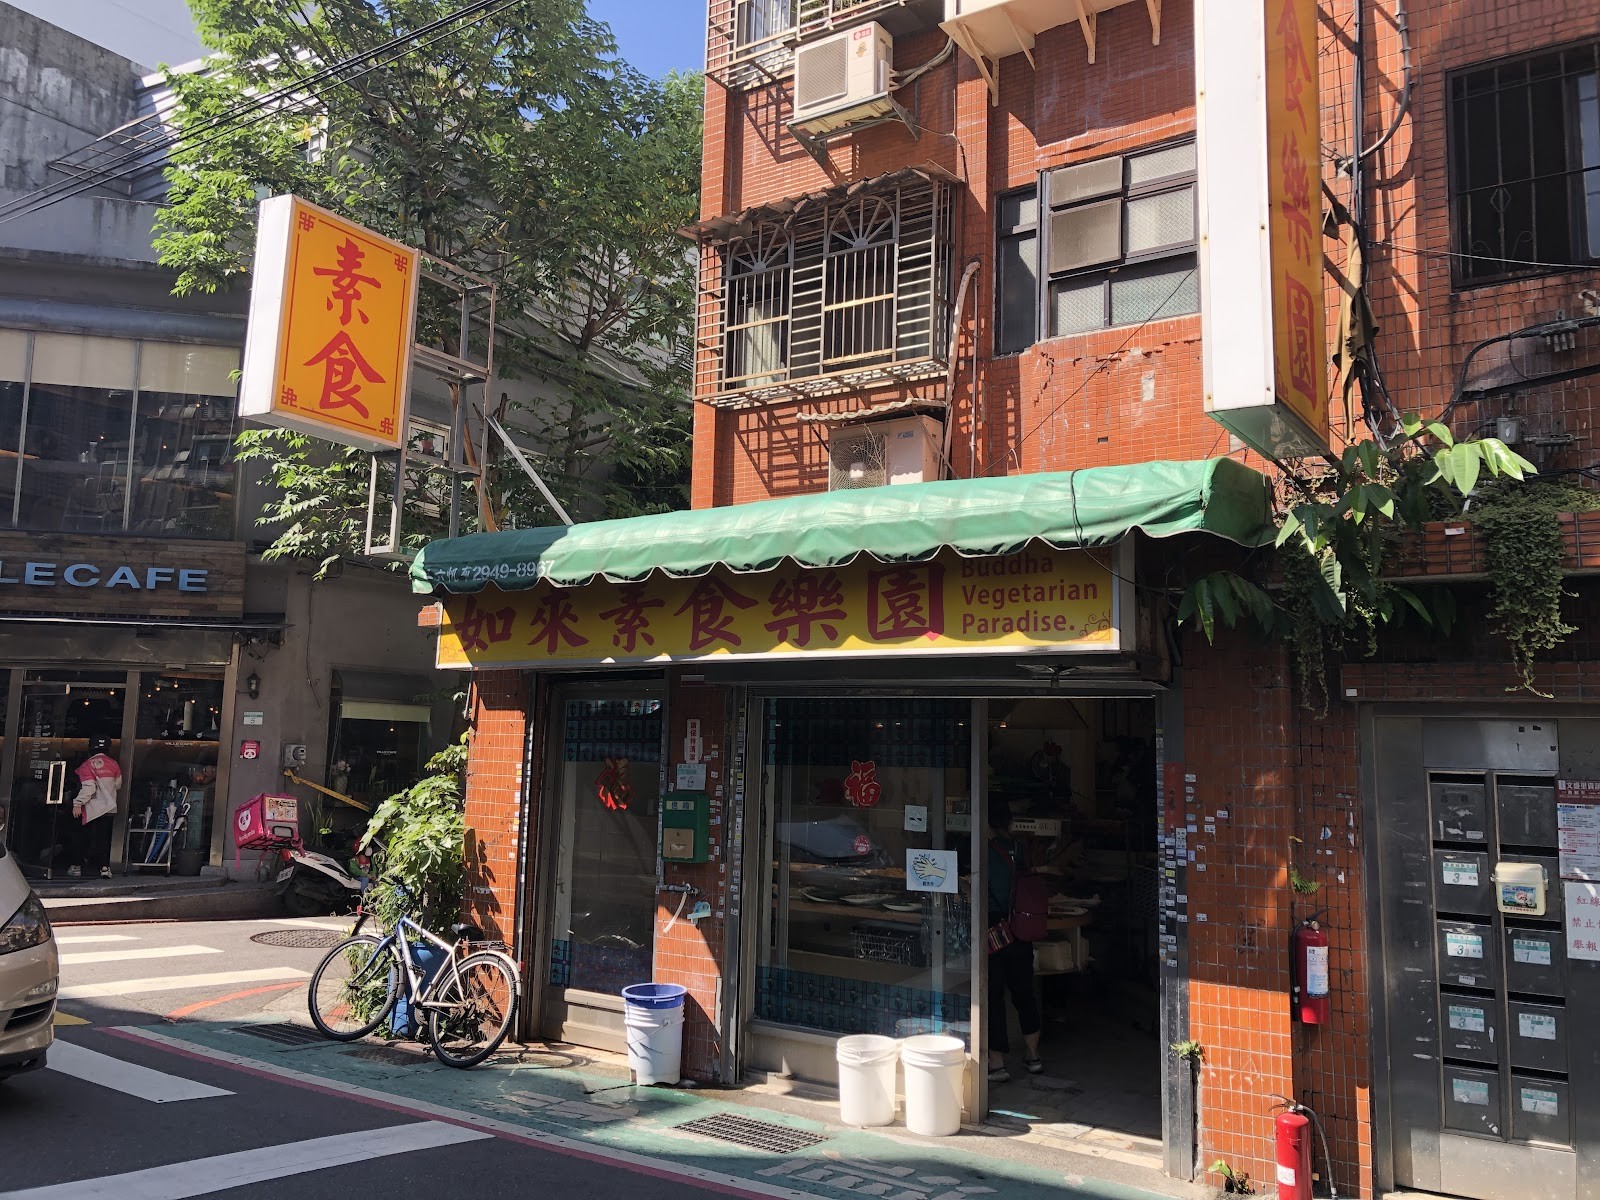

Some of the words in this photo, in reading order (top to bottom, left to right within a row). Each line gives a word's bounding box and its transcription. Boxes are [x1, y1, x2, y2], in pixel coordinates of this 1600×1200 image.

[303, 237, 386, 419] 素食
[0, 561, 208, 592] LECAFE
[961, 553, 1054, 578] Buddha
[454, 561, 946, 654] 如來素食樂園
[962, 579, 1098, 609] Vegetarian
[962, 610, 1075, 634] Paradise.
